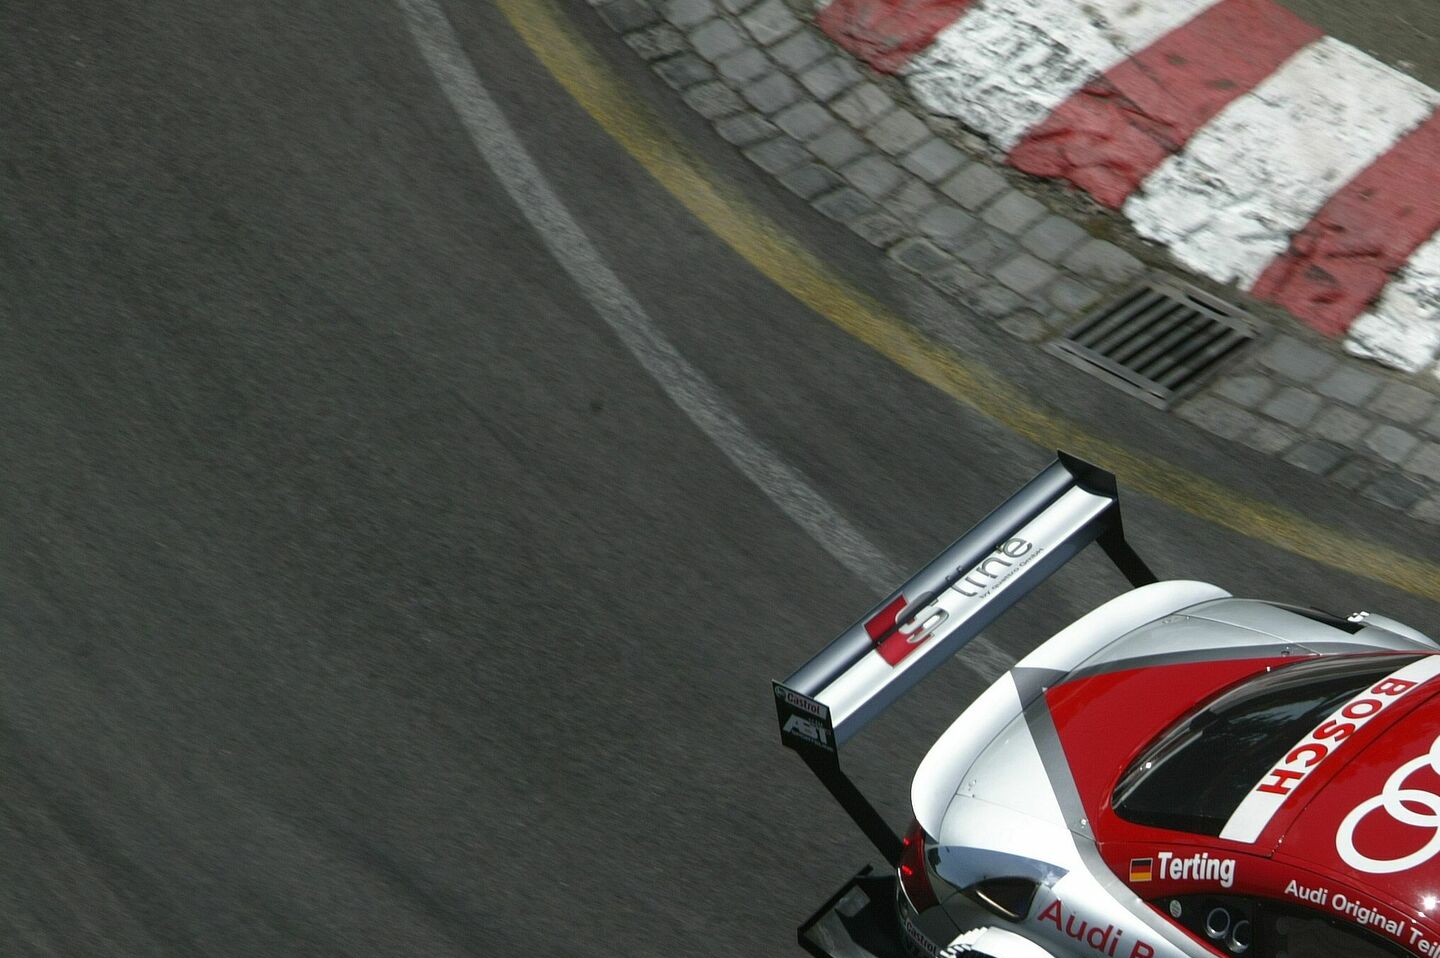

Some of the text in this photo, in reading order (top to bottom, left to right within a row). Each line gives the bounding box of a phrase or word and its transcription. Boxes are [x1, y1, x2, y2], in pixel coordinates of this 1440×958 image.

[946, 537, 1033, 598] line
[787, 692, 821, 714] Castrol
[1256, 677, 1418, 795] BOSCH
[1157, 852, 1236, 887] Terting
[1037, 898, 1122, 957] Audi
[1284, 879, 1328, 906] Audi
[1331, 894, 1404, 937] Original
